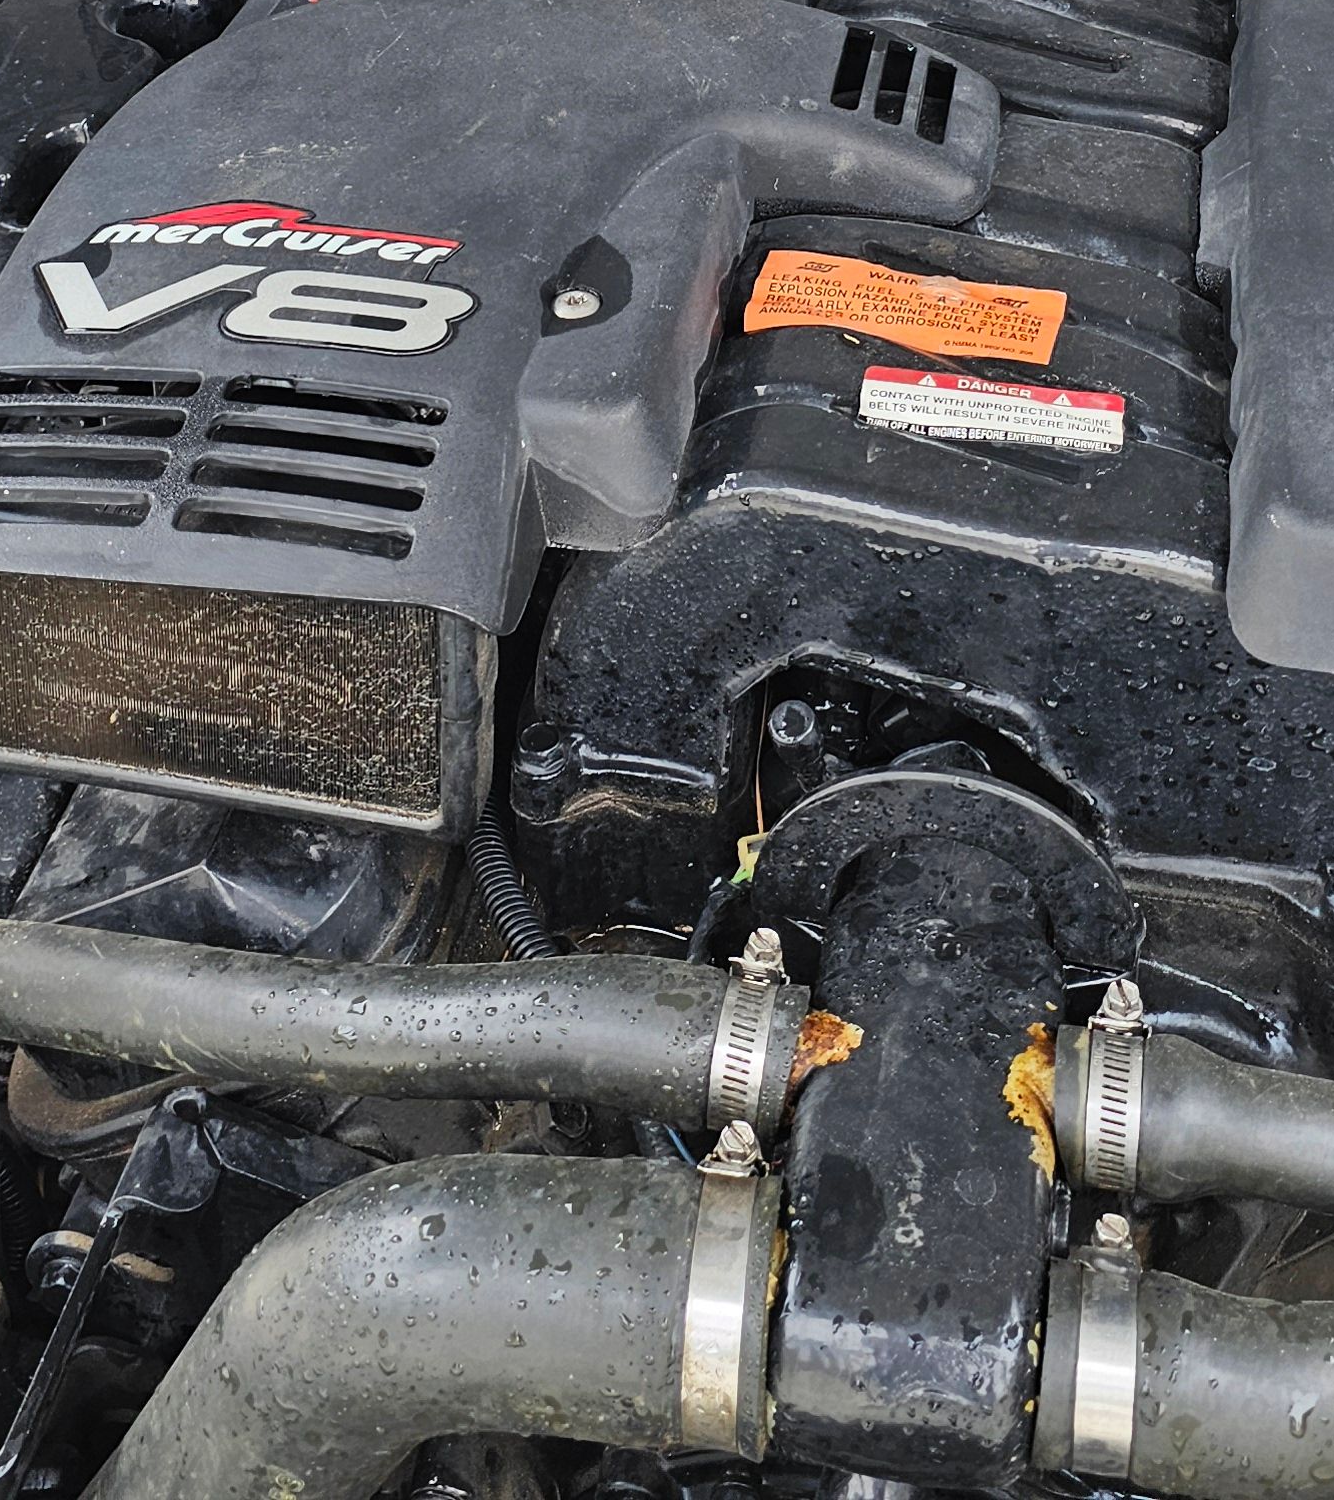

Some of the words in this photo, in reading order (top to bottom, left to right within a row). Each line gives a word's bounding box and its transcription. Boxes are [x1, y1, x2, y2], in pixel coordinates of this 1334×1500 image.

[89, 218, 458, 265] merCruiser
[38, 261, 475, 353] V8
[768, 281, 847, 299] EXPLOSION
[852, 290, 912, 308] HAZARD.
[918, 300, 980, 317] INSPECT
[983, 310, 1042, 328] SYSTEM
[771, 273, 842, 288] LEAKING
[856, 283, 896, 297] FUEL
[909, 291, 924, 301] IS
[937, 295, 947, 304] A
[958, 299, 997, 312] FIRE
[765, 293, 855, 311] REGULARLY.
[861, 301, 927, 318] EXAMINE
[934, 310, 972, 325] FUEL
[979, 318, 1040, 337] SYSTEM
[849, 312, 870, 324] OR
[874, 314, 965, 332] CORROSION
[966, 326, 984, 334] AT
[989, 329, 1039, 344] LEAST
[957, 378, 1032, 399] DANGER
[868, 401, 907, 413] BELTS
[910, 404, 941, 416] WILL
[944, 408, 995, 421] RESULT
[997, 413, 1010, 423] IN
[1013, 415, 1065, 430] SEVERE
[870, 389, 929, 403] CONTACT
[933, 395, 964, 408] WITH
[968, 399, 1063, 419] UNPROTECTED
[1066, 412, 1113, 428] ENGINE
[866, 416, 889, 430] TURN
[890, 420, 910, 432] OFF
[909, 422, 927, 436] ALL
[928, 425, 968, 439] ENGINES
[968, 427, 1007, 442] BEFORE
[1007, 431, 1053, 446] ENTERING
